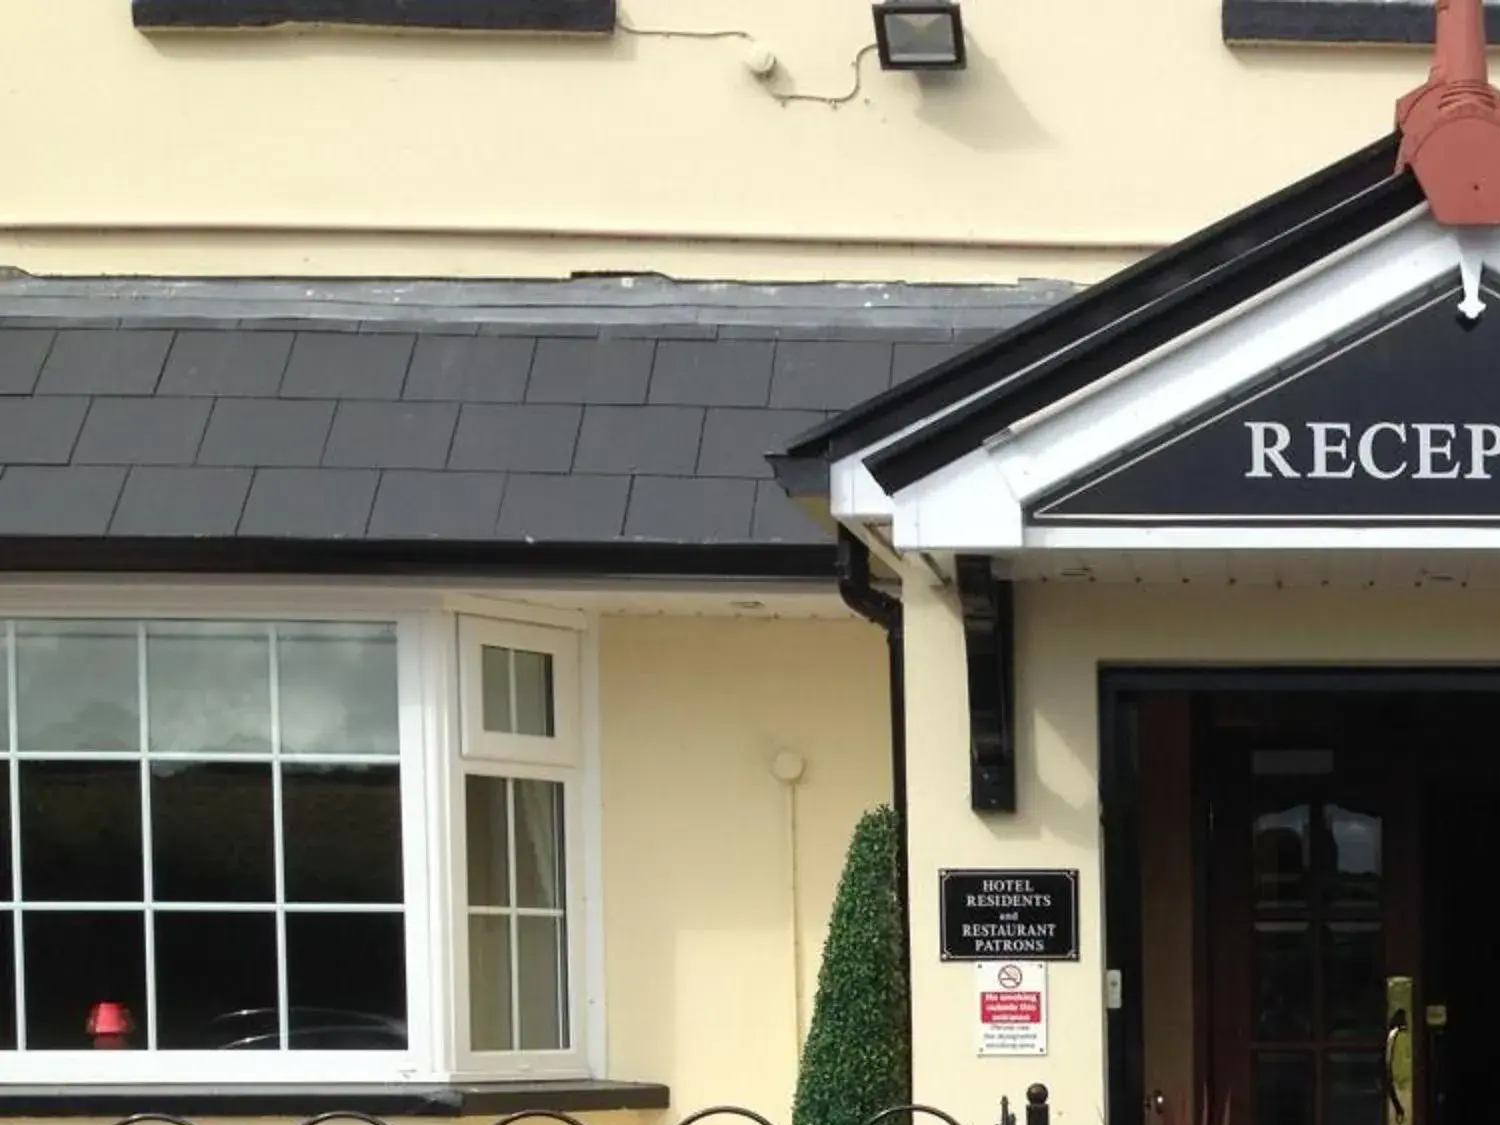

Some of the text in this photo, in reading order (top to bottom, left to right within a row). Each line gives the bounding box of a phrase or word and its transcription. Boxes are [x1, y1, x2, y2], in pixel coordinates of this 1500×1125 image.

[982, 879, 1035, 892] HOTEL
[966, 895, 1052, 907] RESIDENTS
[999, 911, 1019, 920] and
[963, 924, 1057, 937] RESTAURANT
[975, 939, 1044, 952] PATRONS
